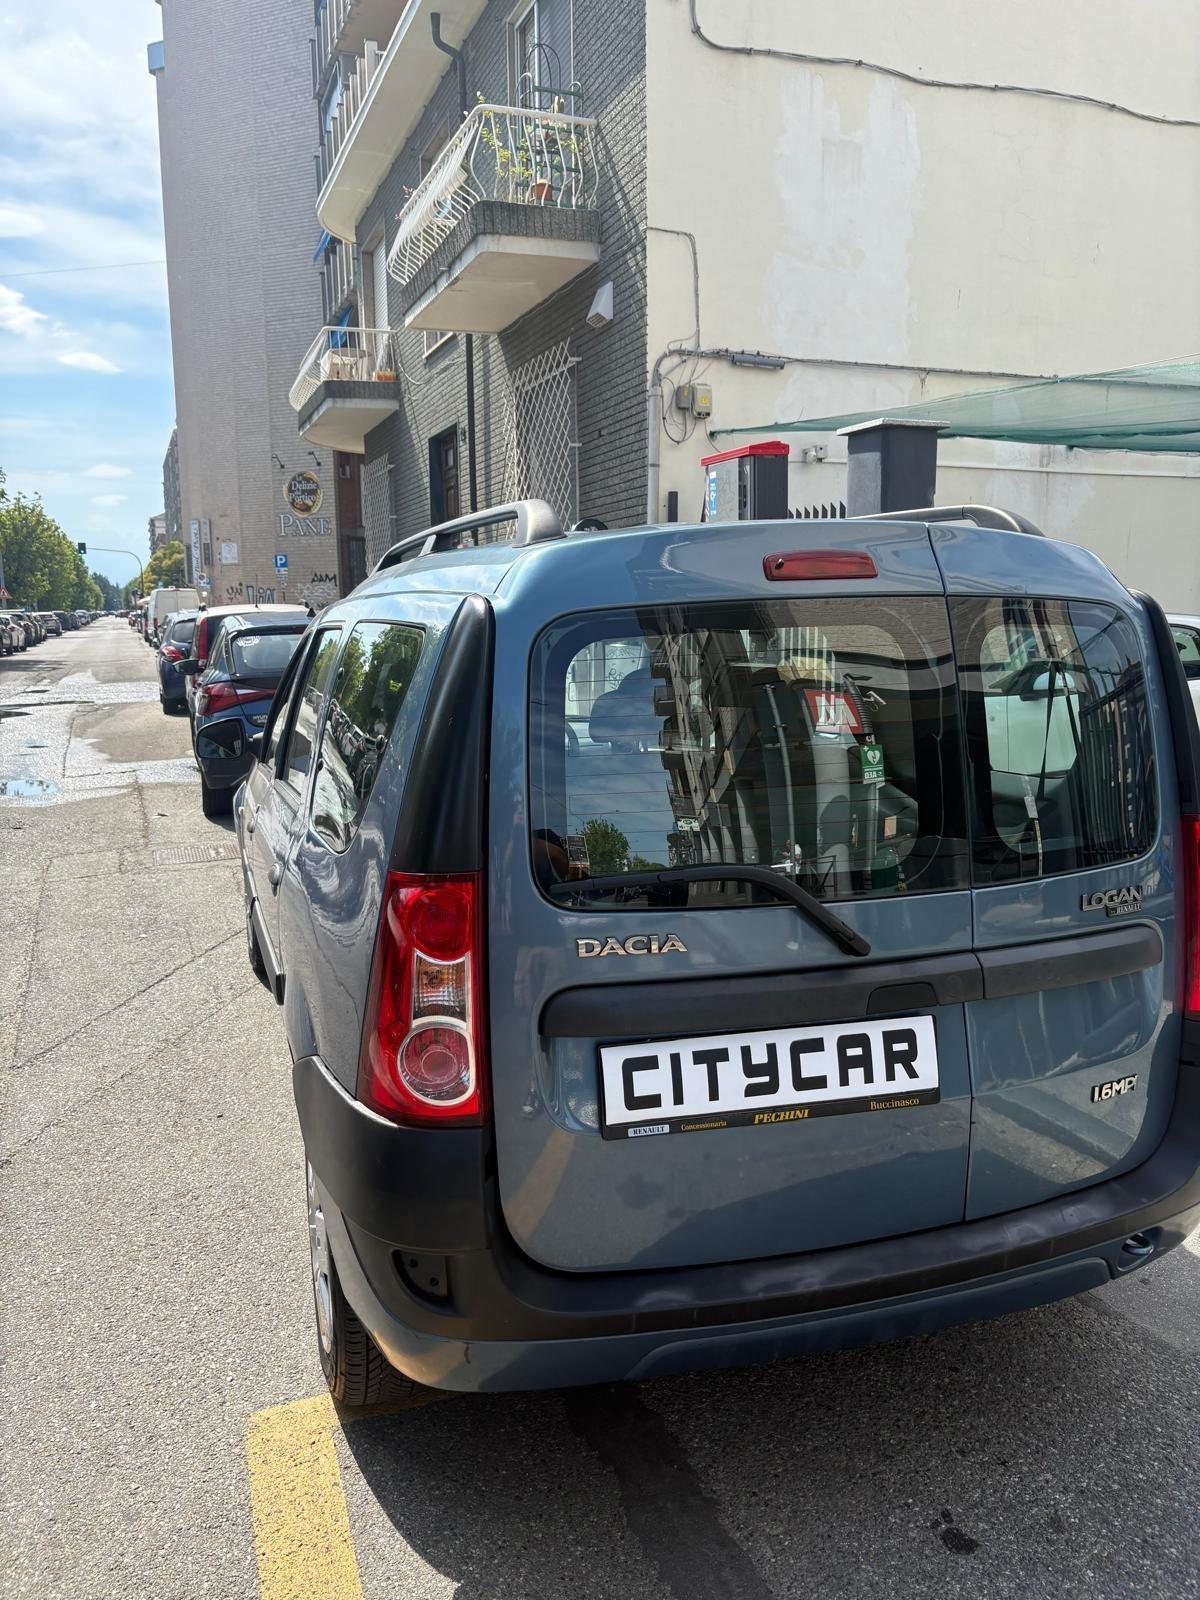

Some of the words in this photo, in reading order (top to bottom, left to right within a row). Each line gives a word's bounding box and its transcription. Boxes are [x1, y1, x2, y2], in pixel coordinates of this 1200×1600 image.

[289, 492, 316, 502] Portico
[279, 513, 332, 536] PANE
[277, 556, 285, 567] P
[1082, 886, 1141, 911] LOGAN
[1116, 902, 1142, 915] RENAULT
[576, 934, 688, 958] DACIA
[621, 1027, 920, 1111] CITYCAR
[632, 1126, 665, 1136] RENAULT
[681, 1120, 728, 1132] Concessionaria
[754, 1109, 810, 1125] PECHINI
[869, 1097, 920, 1111] Buccinasco
